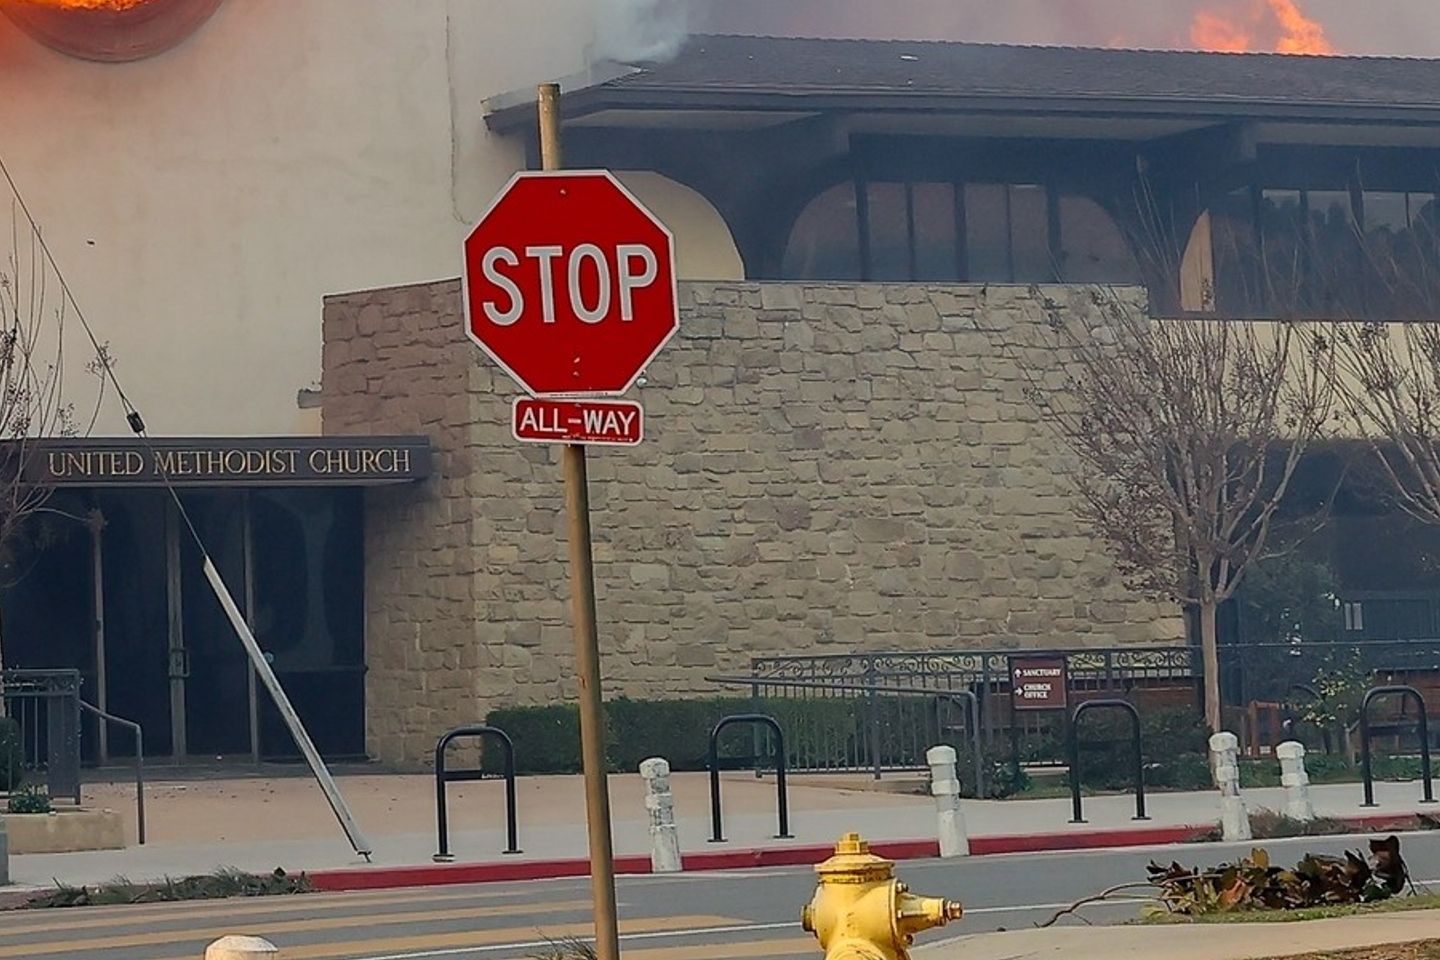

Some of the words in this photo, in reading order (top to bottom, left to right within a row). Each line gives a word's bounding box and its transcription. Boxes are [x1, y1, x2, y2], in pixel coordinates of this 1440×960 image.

[482, 244, 658, 325] STOP
[520, 407, 636, 435] ALL-WAY
[49, 452, 144, 475] UNITED
[153, 450, 300, 474] METHODIST
[309, 449, 410, 472] CHURCH
